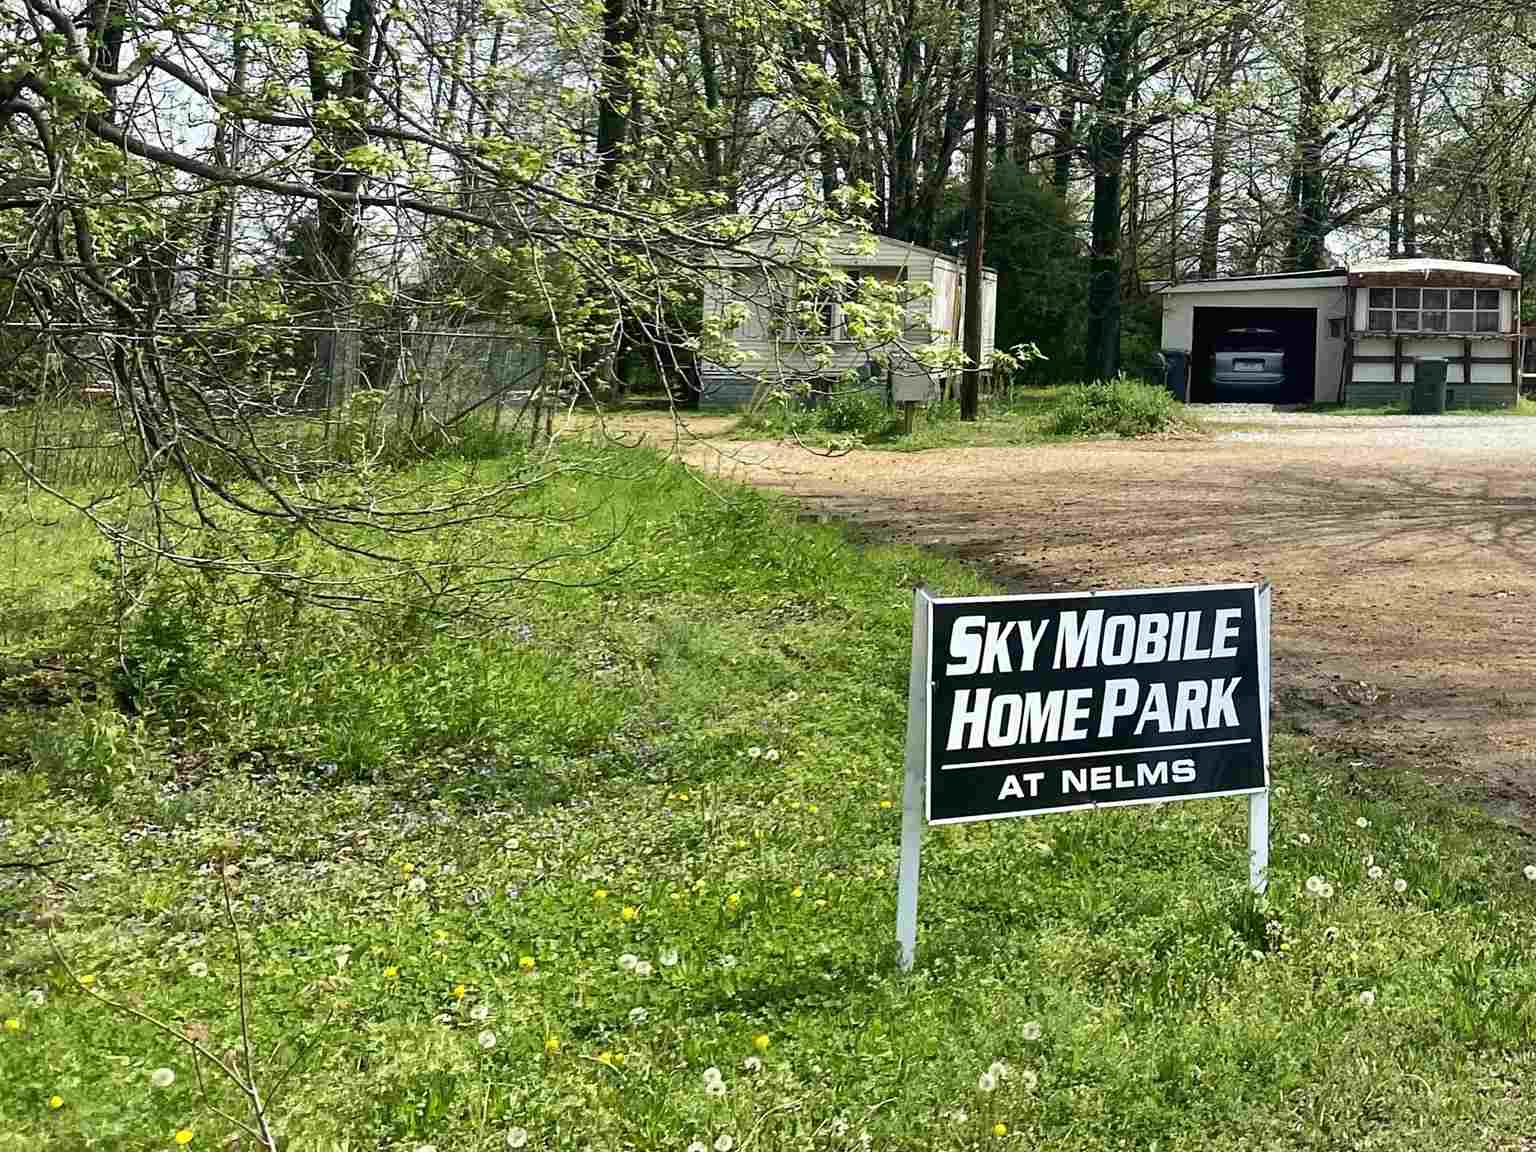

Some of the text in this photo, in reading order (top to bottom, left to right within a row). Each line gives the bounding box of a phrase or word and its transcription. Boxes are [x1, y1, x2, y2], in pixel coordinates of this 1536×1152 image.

[945, 607, 1242, 677] SKY MOBILE
[945, 676, 1243, 751] HOME PARK
[997, 758, 1196, 801] AT NELMS
